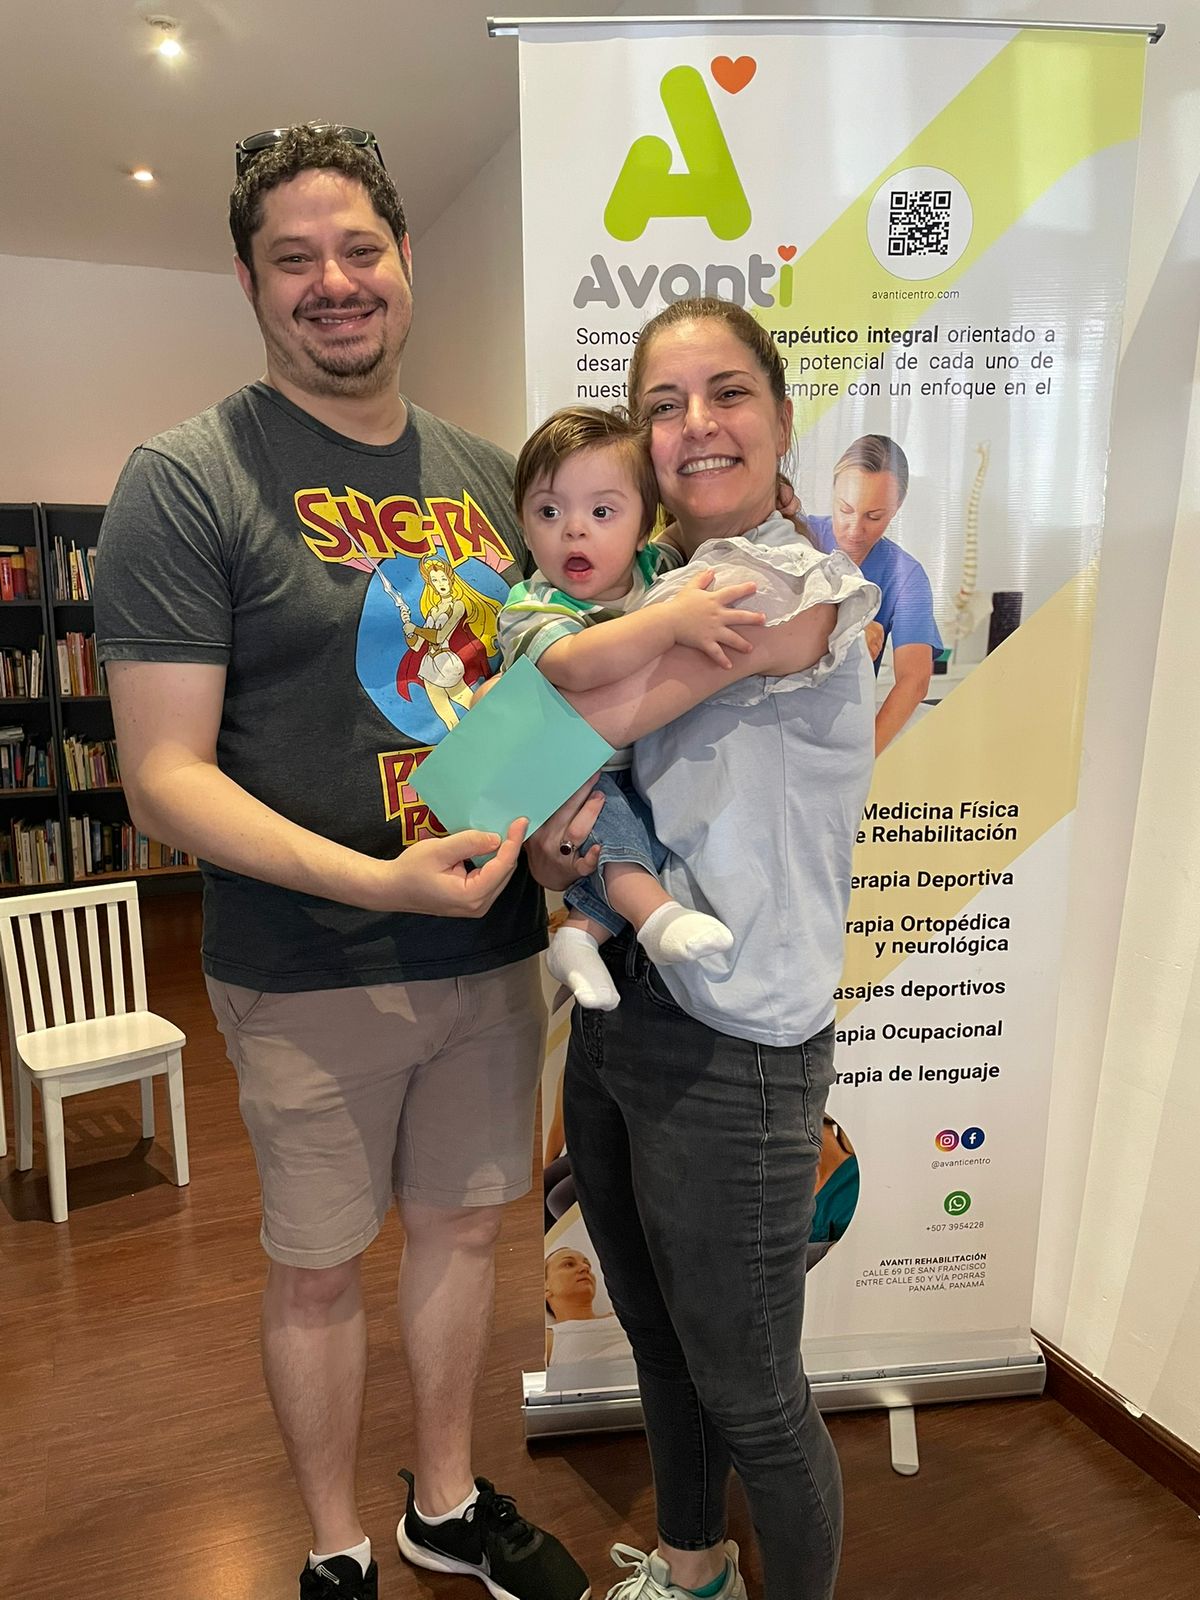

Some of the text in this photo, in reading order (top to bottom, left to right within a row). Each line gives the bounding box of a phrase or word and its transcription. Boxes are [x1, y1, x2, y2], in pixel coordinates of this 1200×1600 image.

[573, 253, 793, 308] Avanti
[871, 289, 960, 300] avanticentro.com
[771, 326, 858, 347] rapéutico
[867, 325, 939, 347] integral
[947, 325, 1036, 343] orientado
[1044, 329, 1055, 343] a
[800, 352, 884, 374] potencial
[895, 351, 918, 370] de
[929, 352, 974, 370] cada
[985, 355, 1019, 370] uno
[1030, 351, 1054, 369] de
[577, 377, 1051, 401] nuest empre con un enfoque en el
[862, 800, 1019, 820] Medicina Física
[872, 823, 1017, 843] Rehabilitación
[851, 869, 1014, 892] erapia Deportiva
[846, 914, 1010, 937] rapia Ortopédica
[875, 936, 1009, 958] y neurológica
[833, 979, 1006, 1002] asajes deportivos
[836, 1020, 1003, 1046] apia Ocupacional
[836, 1063, 1000, 1087] rapia de lenguaje
[931, 1158, 991, 1169] @avanticentro
[926, 1221, 984, 1232] +507 3954228
[863, 1262, 986, 1277] CALLE 69 DE SAN FRANCISCO
[880, 1253, 987, 1267] AVANTI REHABILITACIÓN
[856, 1270, 986, 1288] ENTRE CALLE 50 Y VÍA PORRAS
[949, 1279, 985, 1290] PANAMÁ
